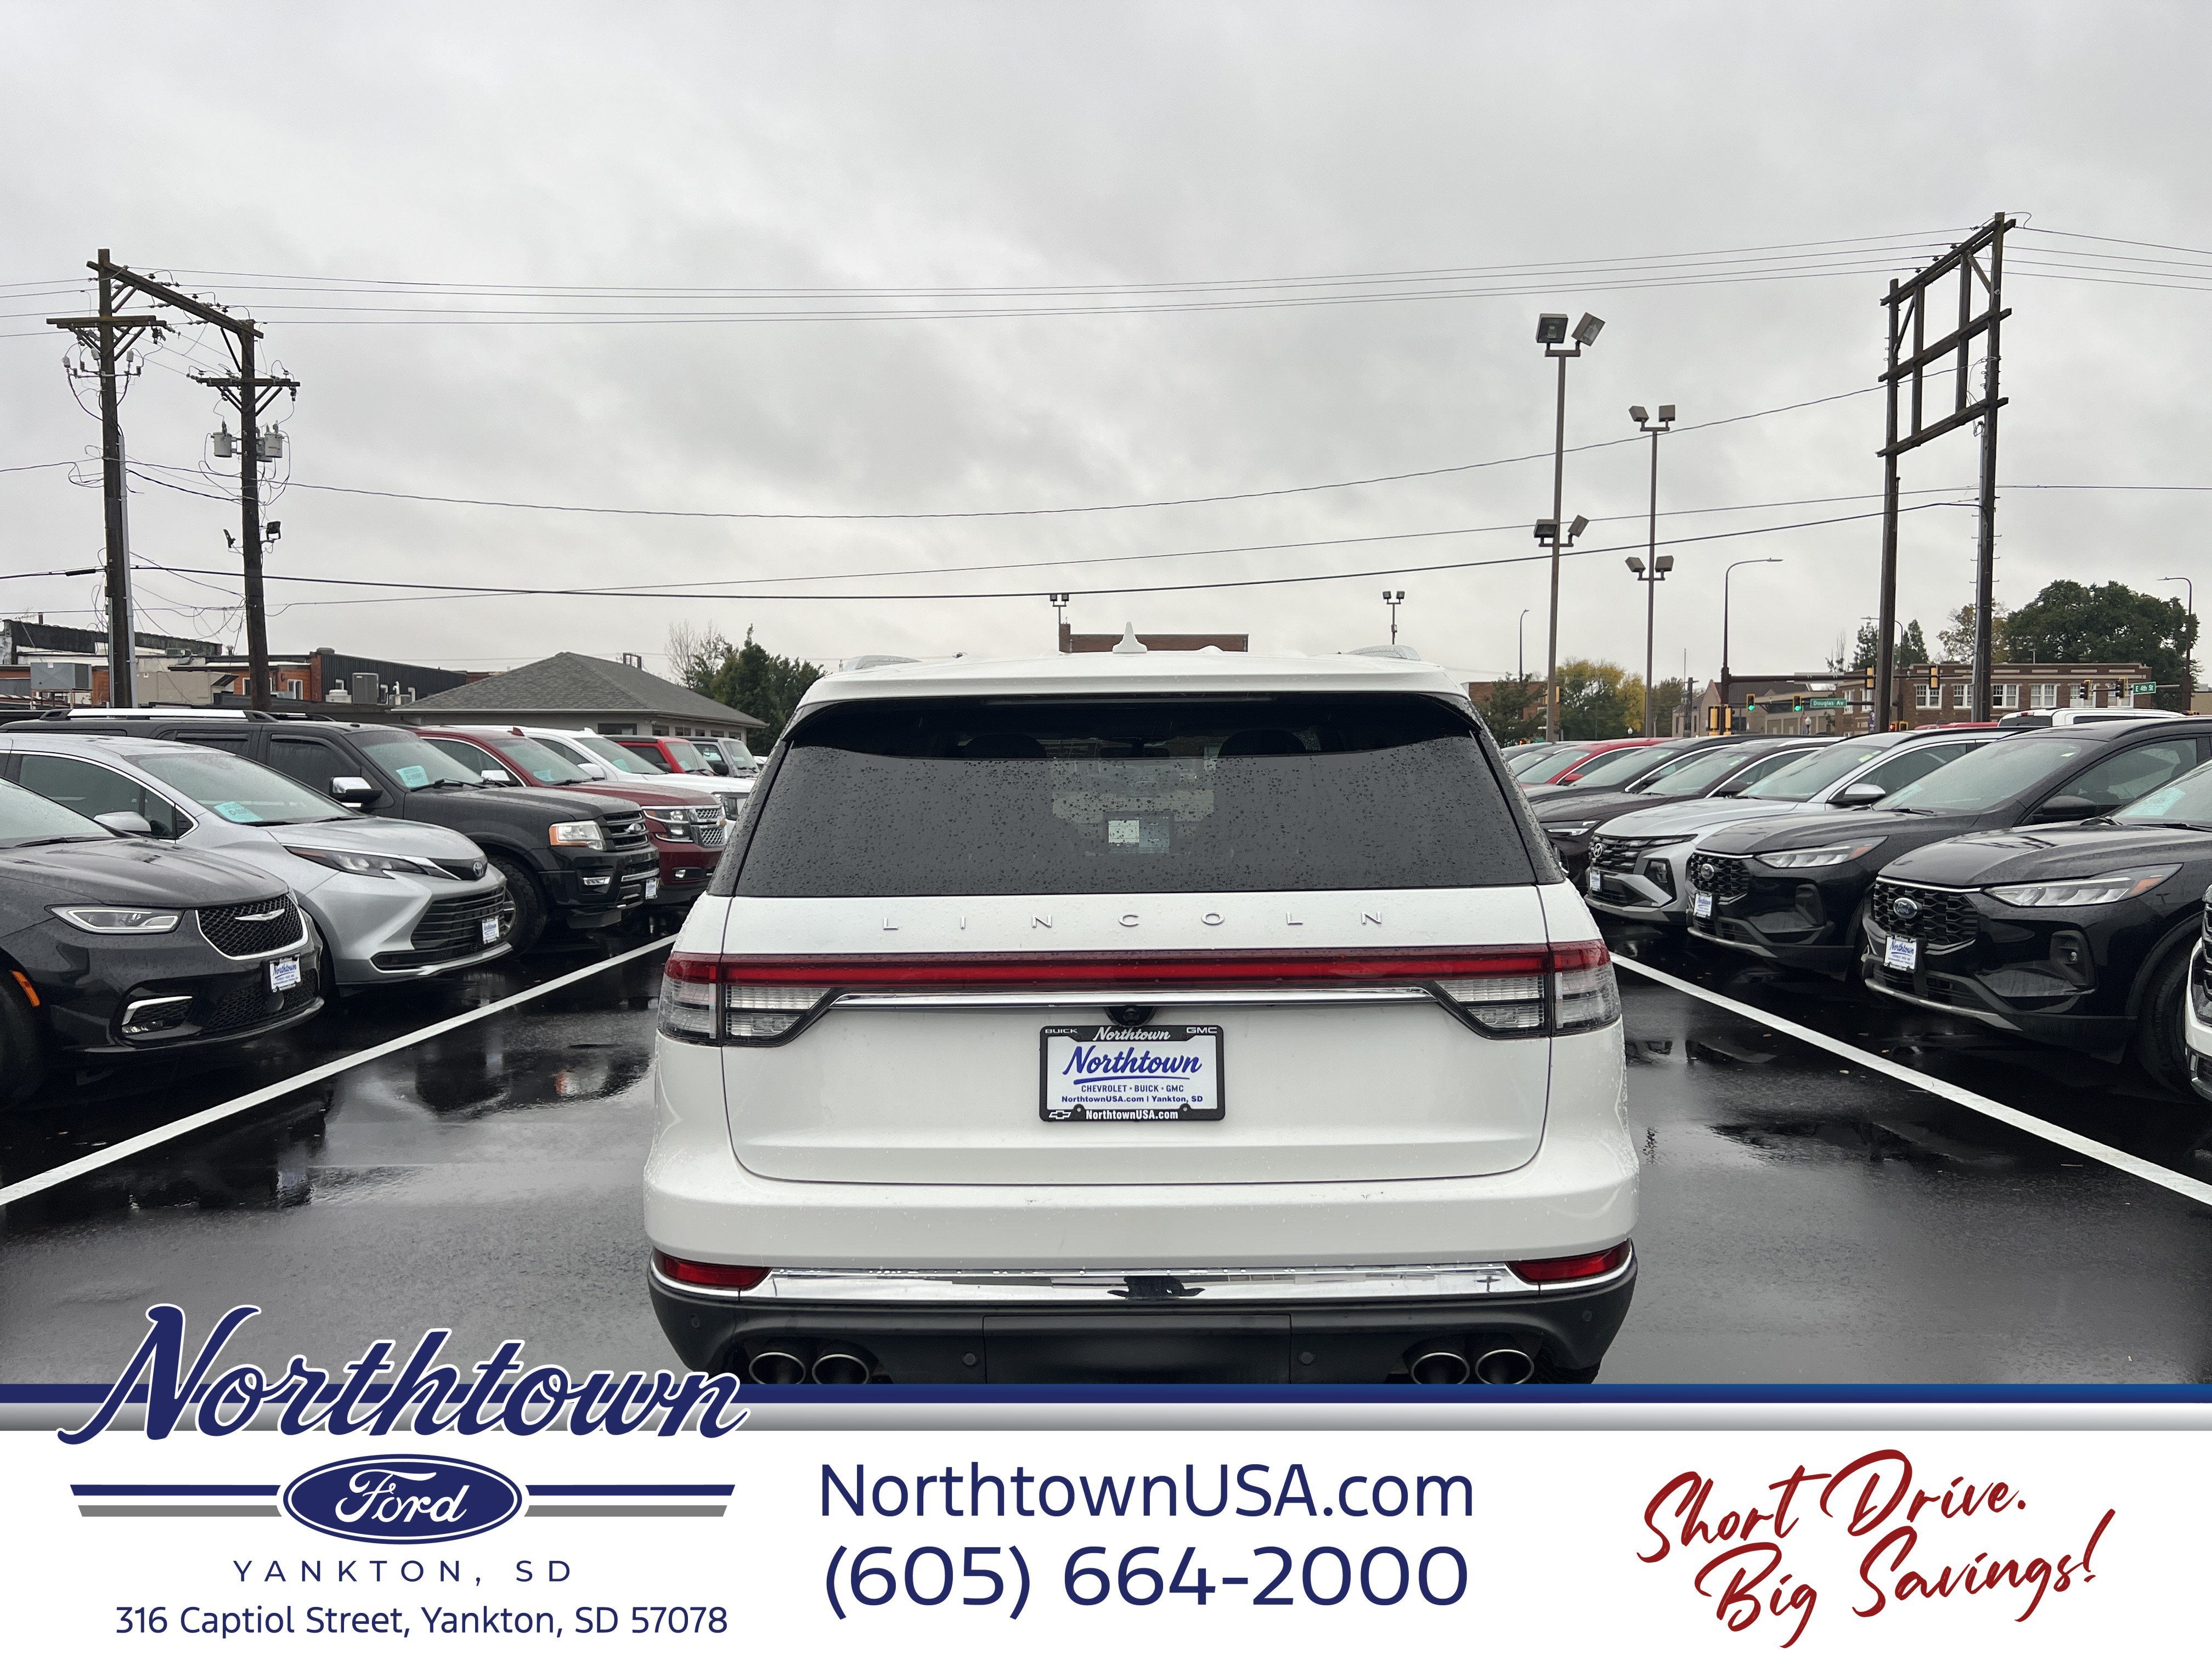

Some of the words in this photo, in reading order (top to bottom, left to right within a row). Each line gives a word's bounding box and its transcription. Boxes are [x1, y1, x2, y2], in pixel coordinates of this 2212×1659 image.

[883, 911, 1382, 930] LINCOLN
[1092, 1026, 1171, 1041] Northtown
[1062, 1045, 1203, 1075] Northtown
[1081, 1085, 1128, 1093] CHEVROLET
[1152, 1096, 1189, 1104] Yankton,
[1086, 1109, 1179, 1120] NorthtownUSA.com
